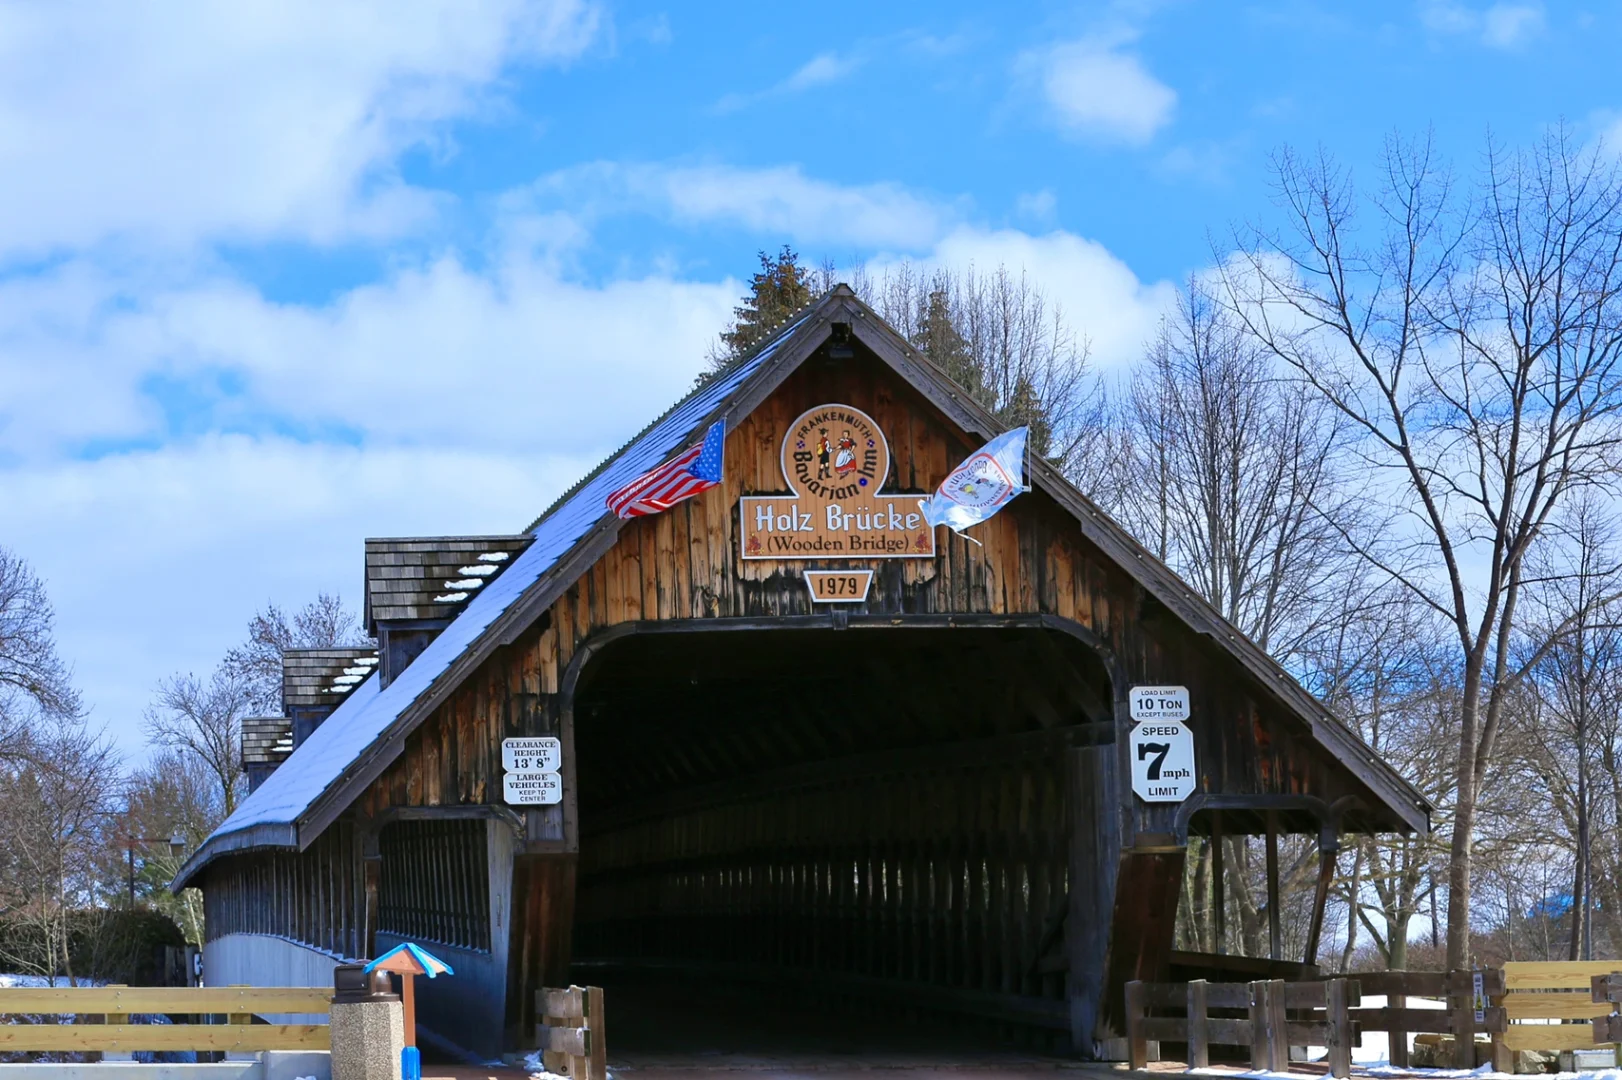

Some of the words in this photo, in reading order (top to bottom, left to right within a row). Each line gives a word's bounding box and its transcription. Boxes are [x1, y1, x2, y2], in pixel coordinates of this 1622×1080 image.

[797, 411, 872, 439] FRANKENMUTH
[793, 450, 860, 500] Bavarian
[857, 449, 877, 479] Inn
[755, 504, 814, 532] Holz
[826, 503, 920, 531] Brücke
[767, 535, 843, 553] (Wooden
[850, 534, 909, 554] Bridge)
[818, 577, 857, 595] 1979
[1137, 698, 1154, 710] 10
[1158, 699, 1182, 709] TON
[1142, 727, 1179, 736] SPEED
[505, 741, 556, 749] CLEARANCE
[1137, 742, 1170, 780] 7
[1163, 768, 1190, 780] mph
[509, 781, 556, 789] VEHICLES
[1148, 787, 1179, 796] LIMIT
